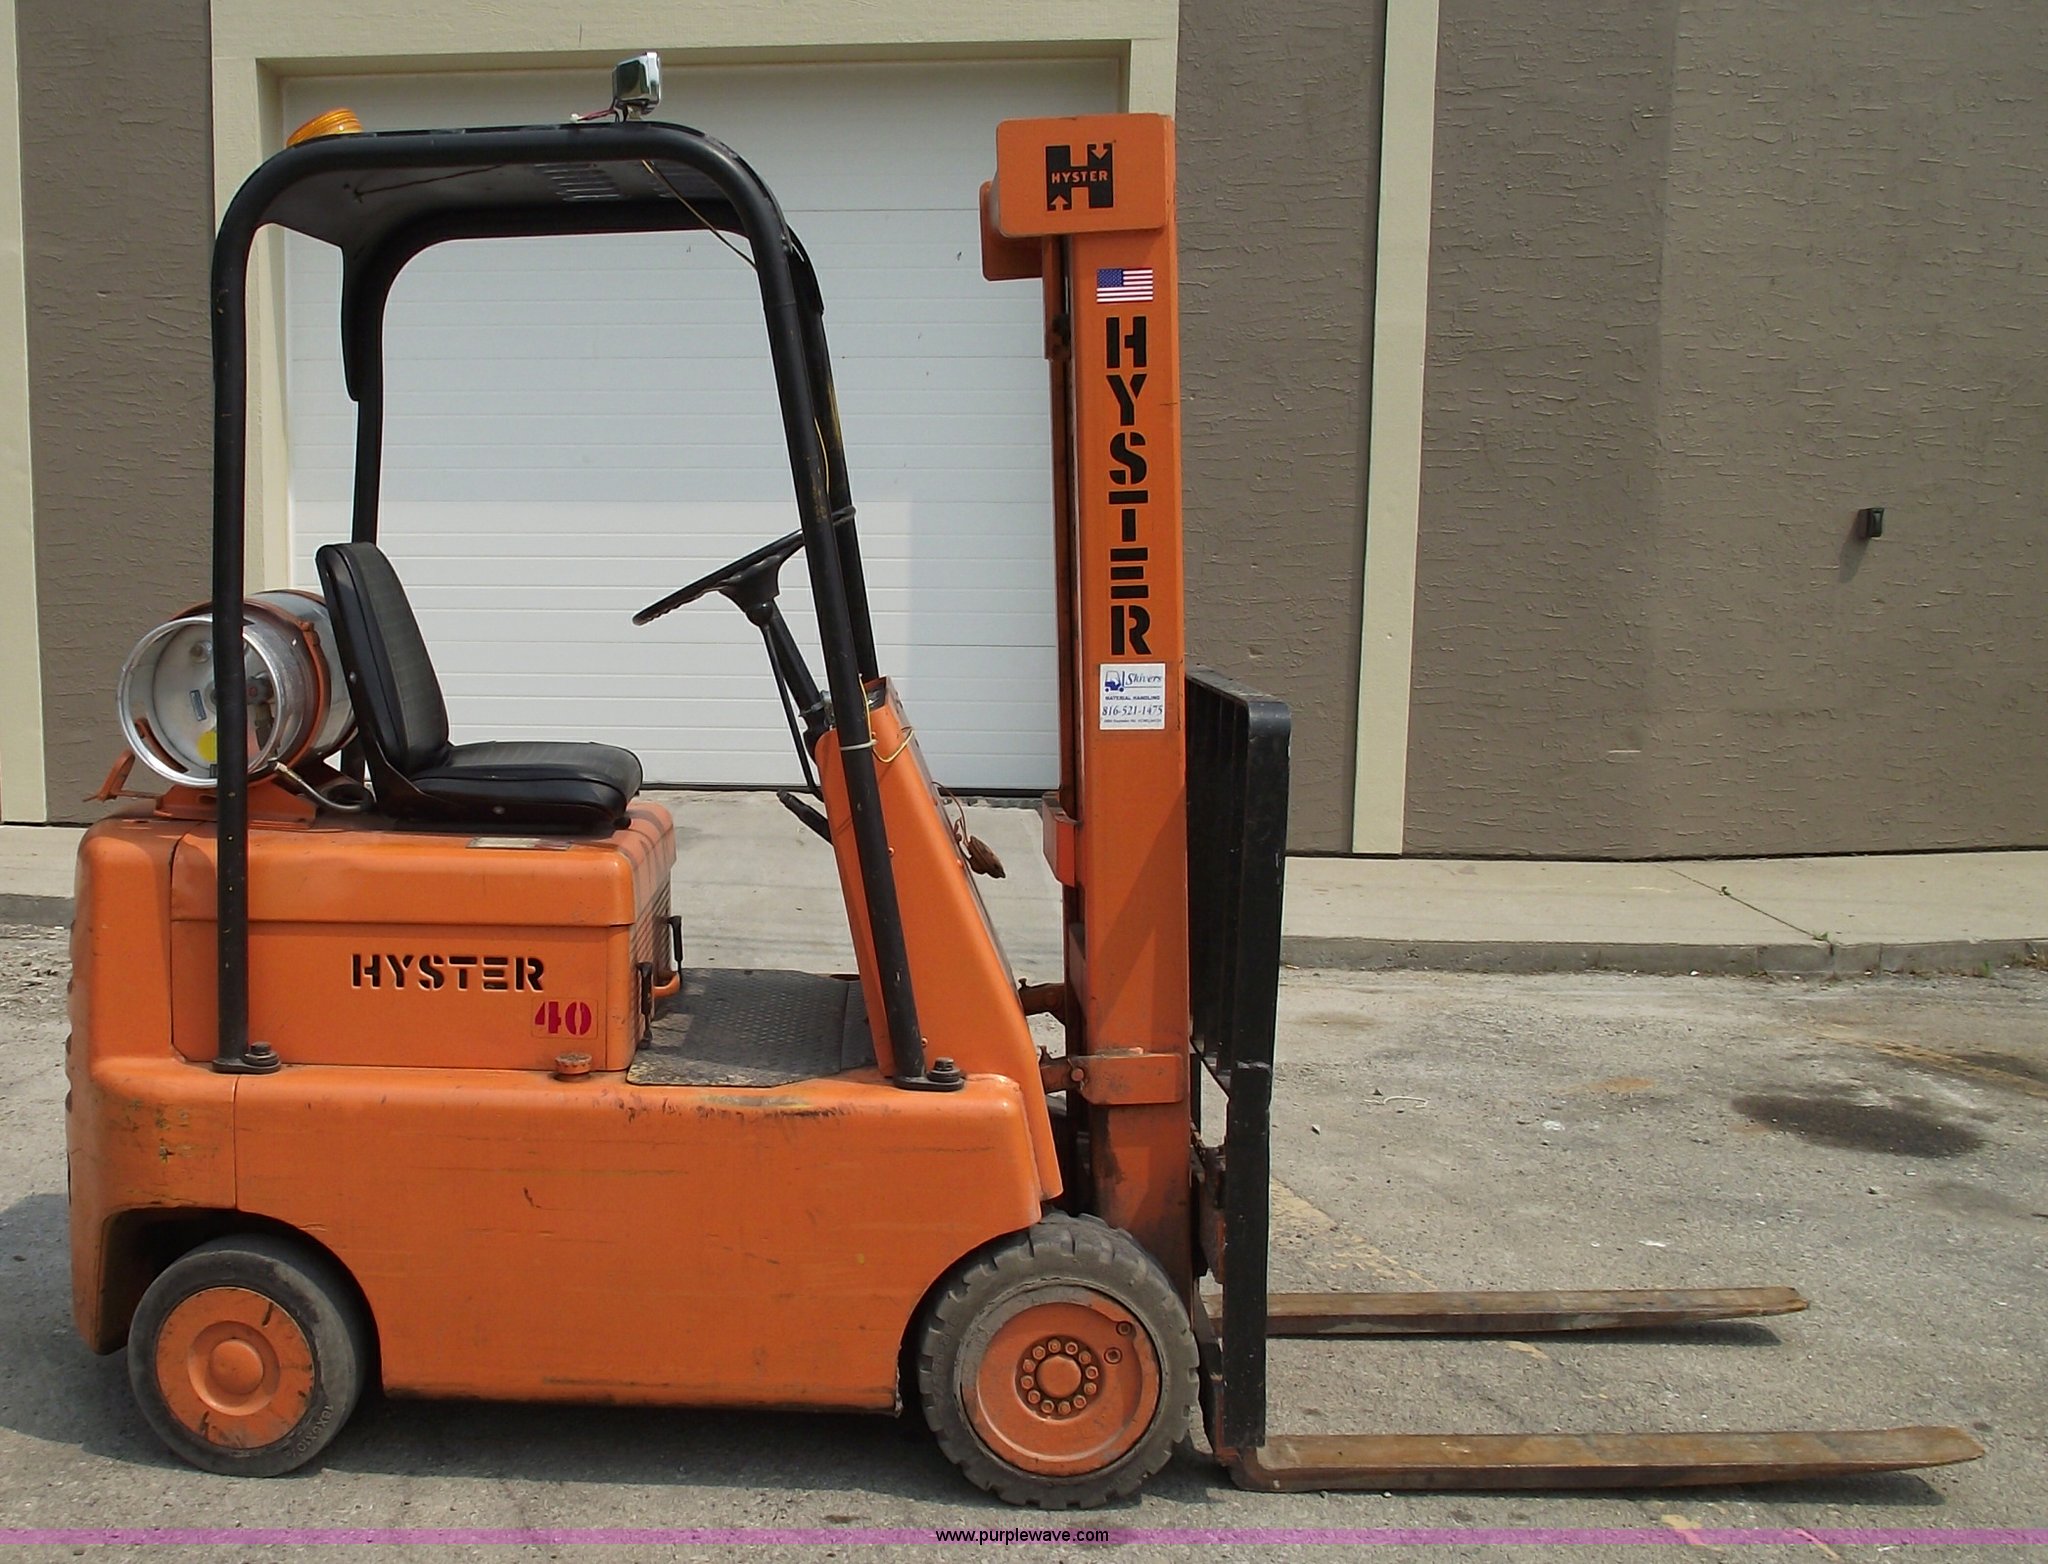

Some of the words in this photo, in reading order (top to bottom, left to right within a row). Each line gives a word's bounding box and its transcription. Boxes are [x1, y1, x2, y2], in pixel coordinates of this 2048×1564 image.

[1051, 170, 1108, 184] HYSTER
[1105, 316, 1152, 656] HYSTER
[1102, 704, 1164, 716] 816-521-1475
[352, 954, 545, 992] HYSTER
[534, 1001, 592, 1036] 40
